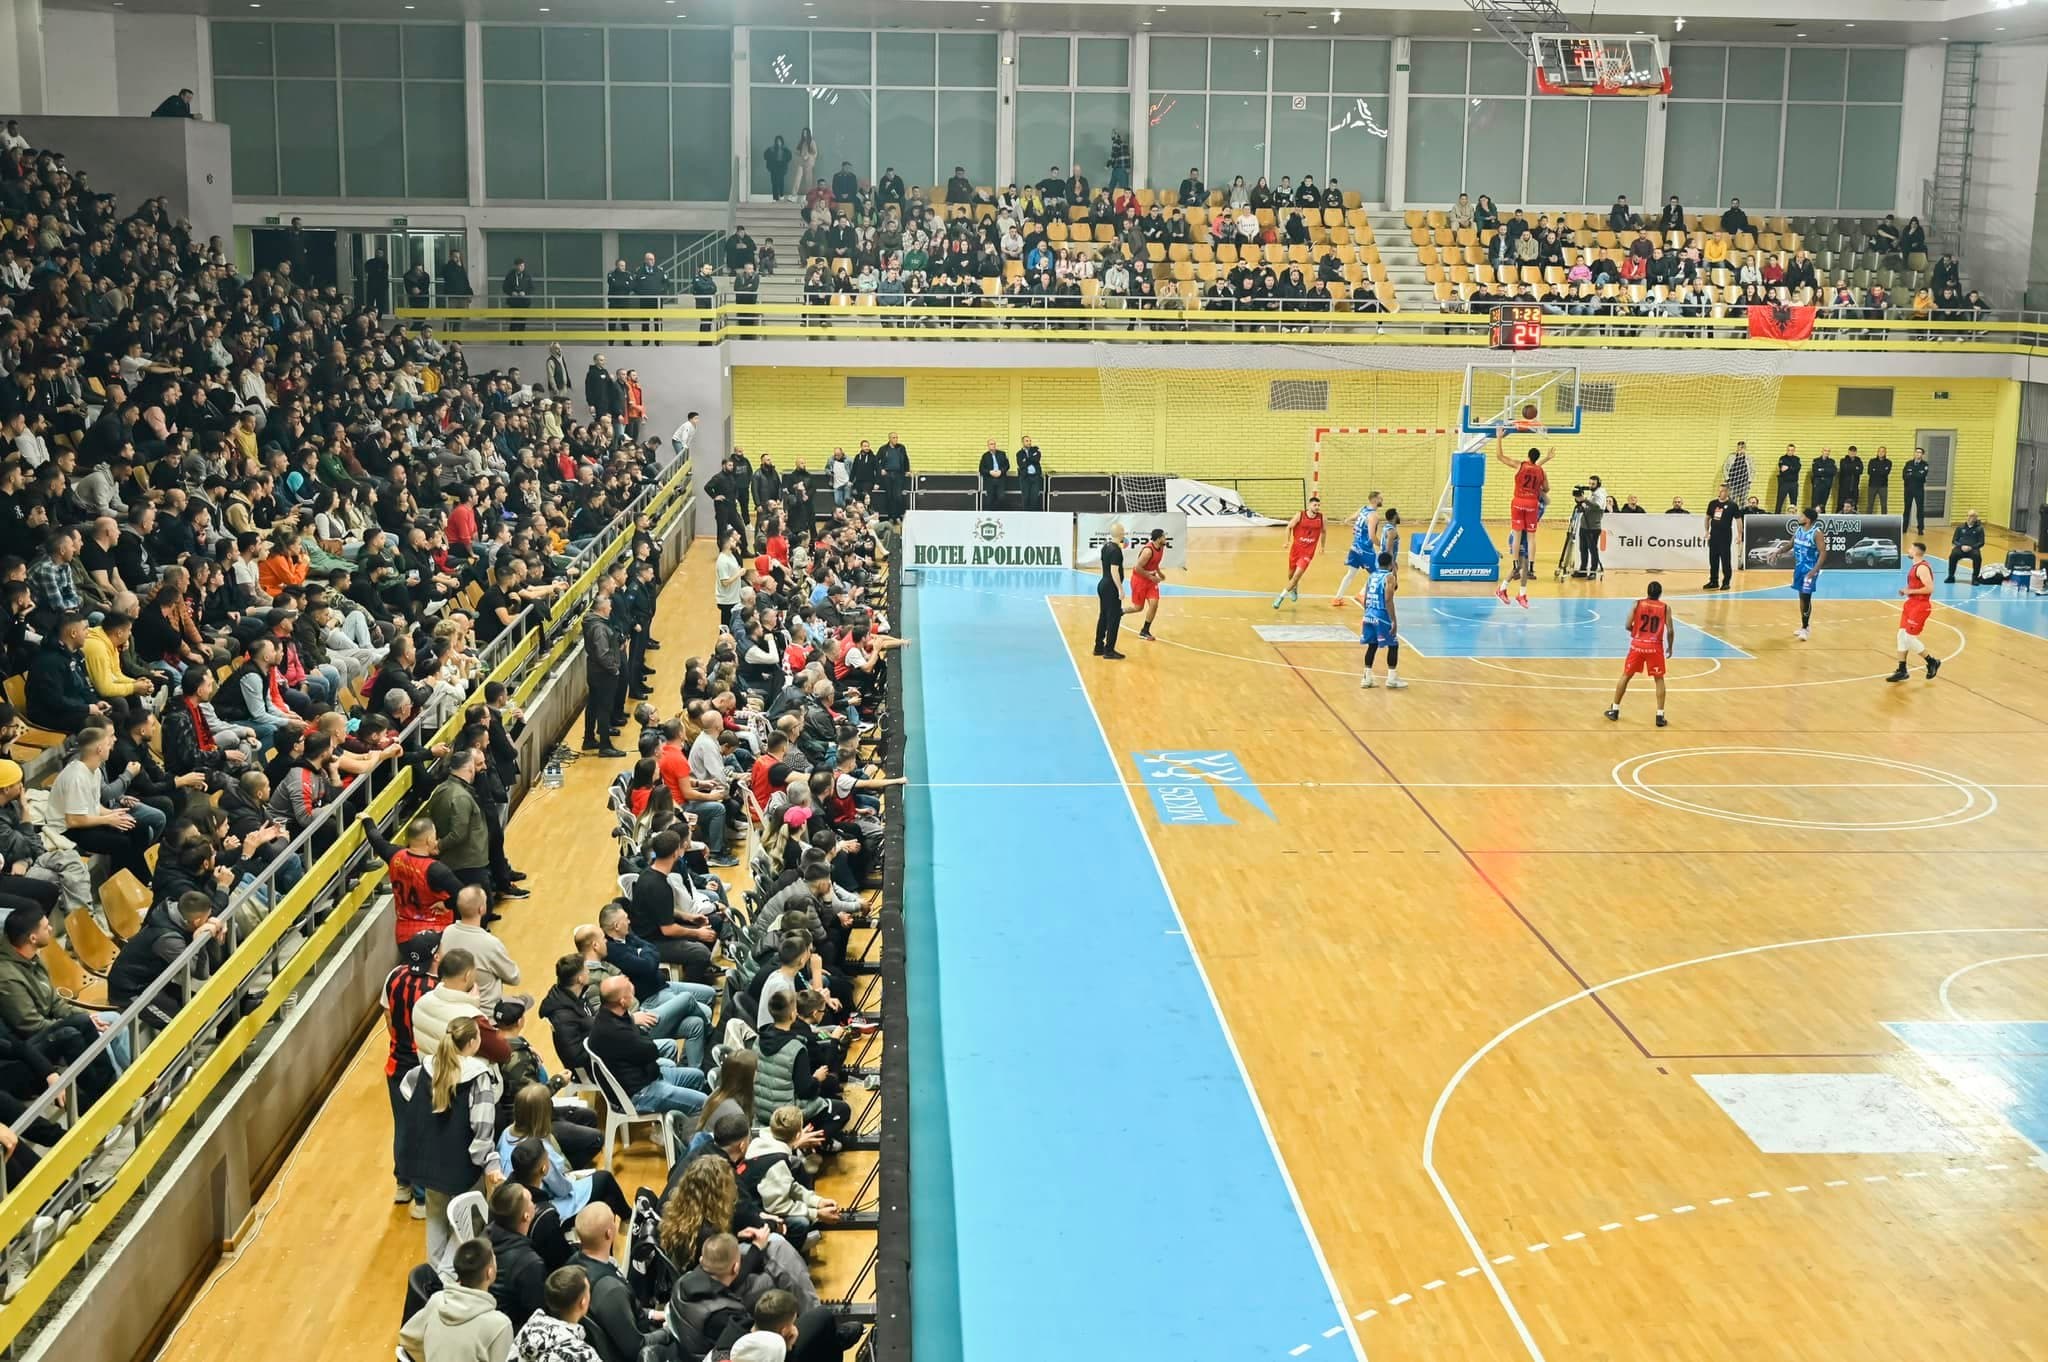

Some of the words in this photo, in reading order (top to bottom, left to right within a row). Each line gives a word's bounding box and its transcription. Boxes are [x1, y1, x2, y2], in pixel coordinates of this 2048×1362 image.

[1512, 308, 1540, 320] 7:22
[1514, 325, 1540, 344] 24
[1522, 474, 1538, 489] 21
[1618, 535, 1642, 547] Tali
[1647, 535, 1706, 548] Consulti
[914, 545, 967, 565] HOTEL
[971, 545, 1062, 566] APOLLONIA
[1639, 614, 1660, 633] 20
[1158, 785, 1208, 822] MKRS
